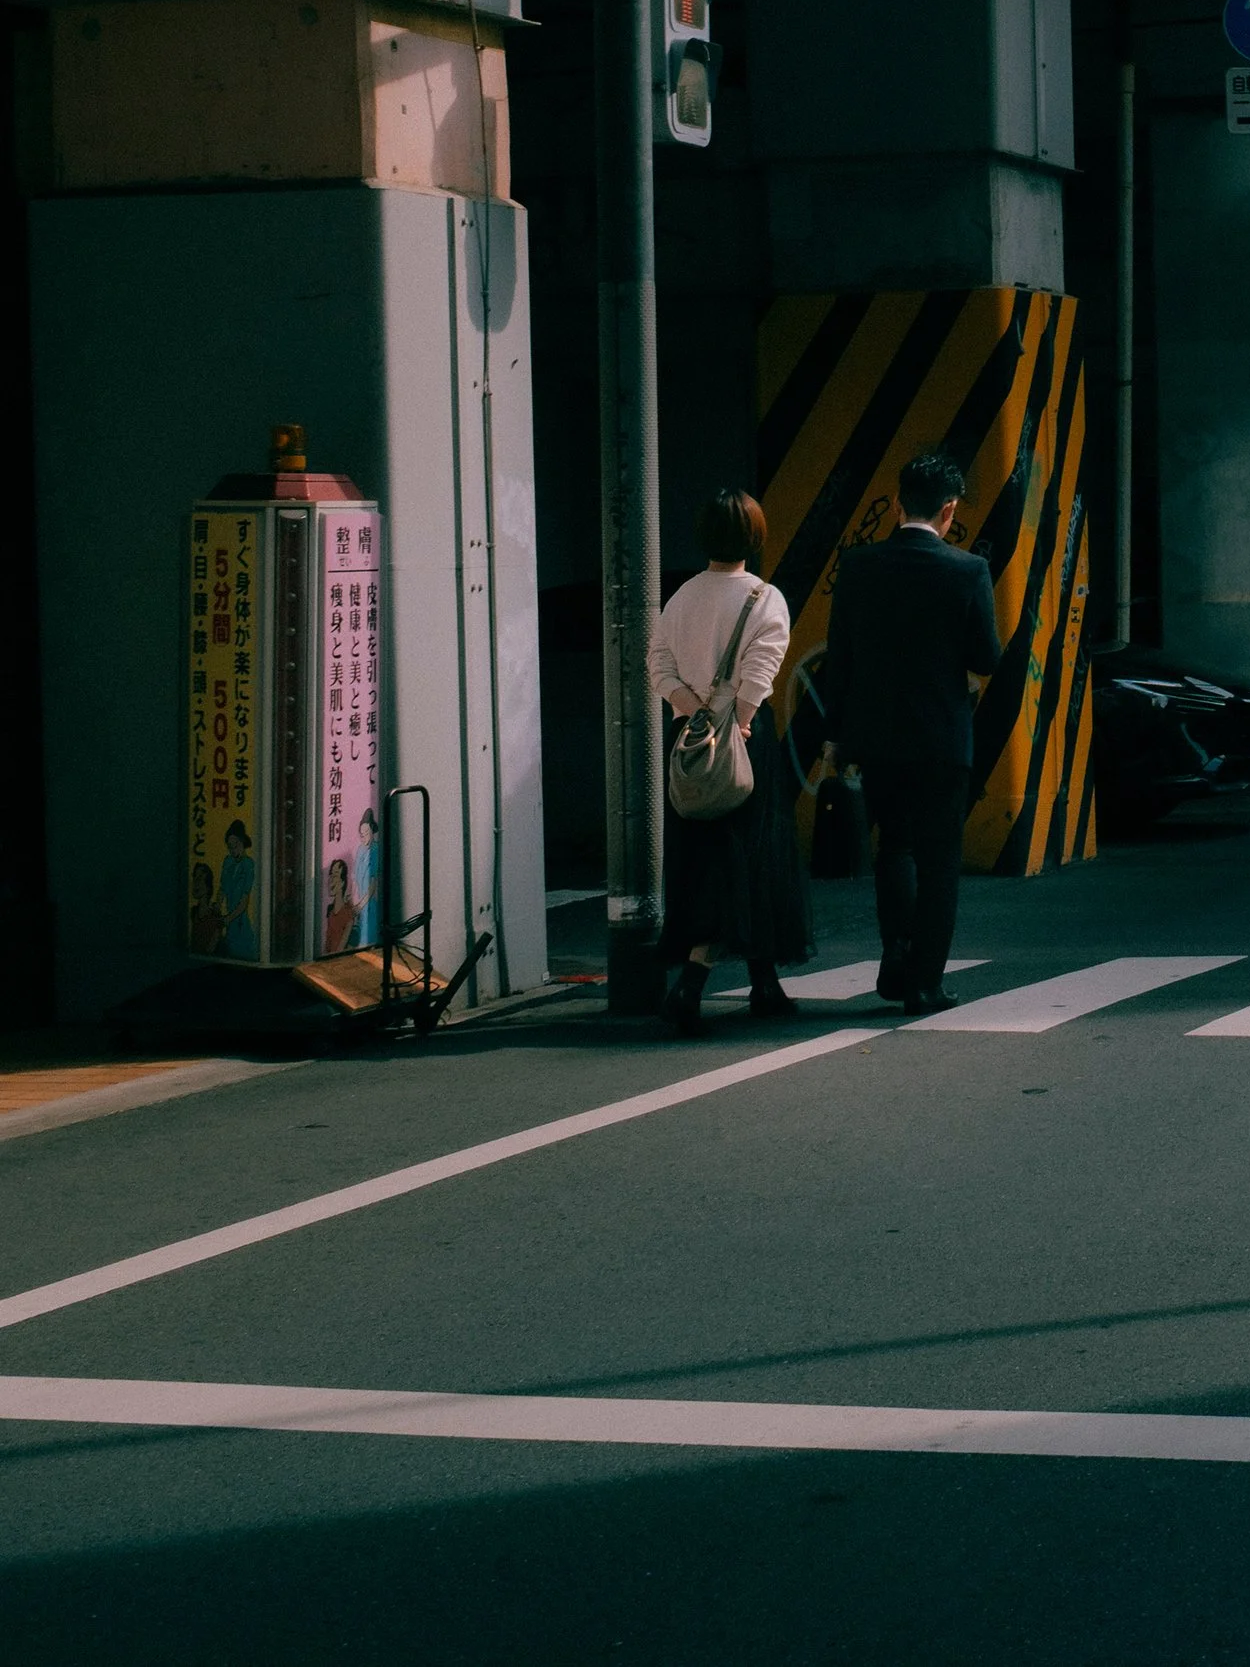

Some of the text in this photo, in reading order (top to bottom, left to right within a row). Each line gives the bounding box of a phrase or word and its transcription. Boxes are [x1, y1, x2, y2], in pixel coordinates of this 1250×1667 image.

[212, 679, 230, 809] 500円
[234, 518, 251, 807] すぐ身体が楽になります
[328, 583, 344, 842] 痩身と美肌にも効果的
[348, 582, 361, 761] 健康と美と癒し
[366, 582, 378, 785] 皮膚を引っ張って
